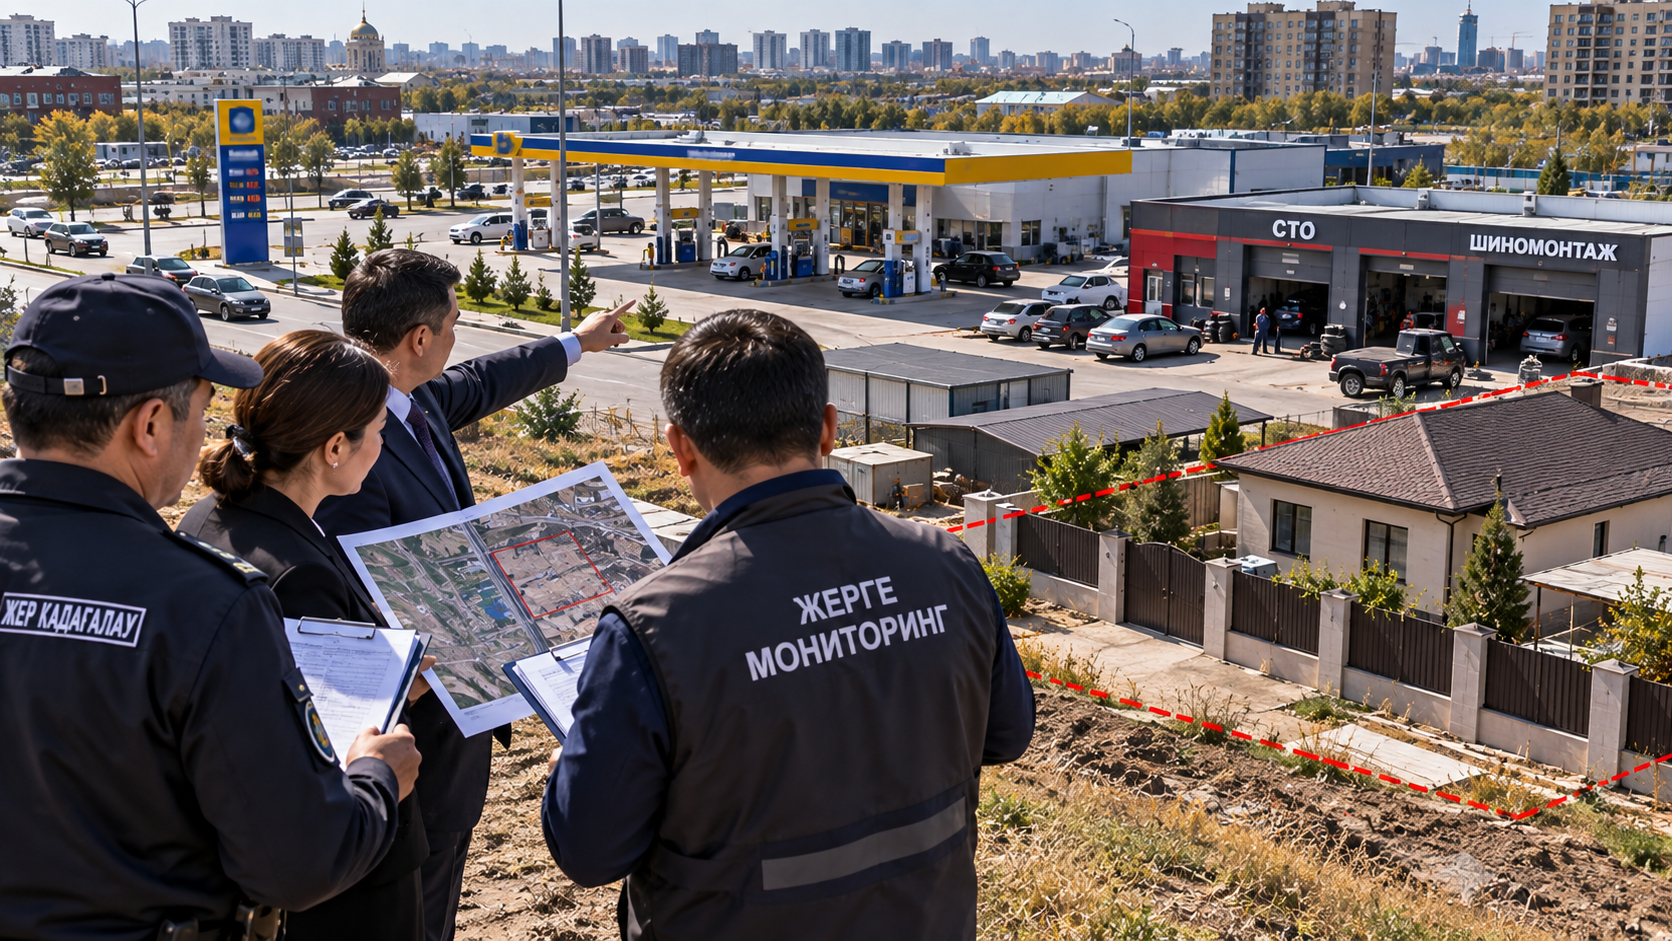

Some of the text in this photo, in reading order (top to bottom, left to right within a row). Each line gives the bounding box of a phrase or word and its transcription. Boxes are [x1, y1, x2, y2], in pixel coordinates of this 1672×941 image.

[1272, 219, 1316, 240] СТО
[1469, 233, 1619, 262] ШИНОМОНТАЖ
[1, 599, 37, 627] ЖЕР
[792, 575, 898, 625] ЖЕРГЕ
[745, 603, 948, 682] МОНИТОРИНГ
